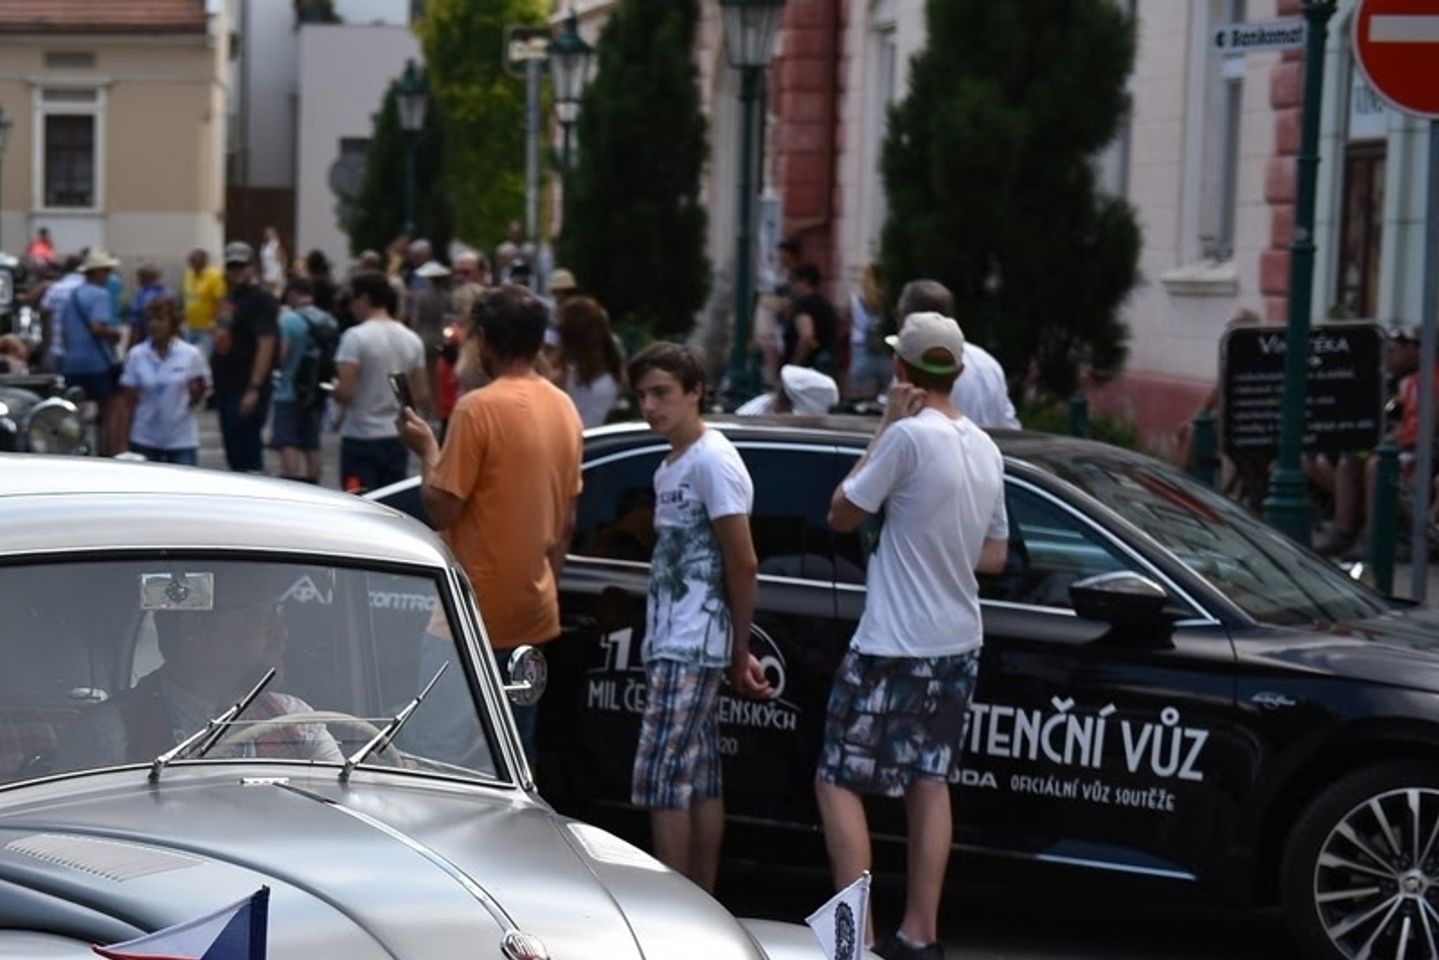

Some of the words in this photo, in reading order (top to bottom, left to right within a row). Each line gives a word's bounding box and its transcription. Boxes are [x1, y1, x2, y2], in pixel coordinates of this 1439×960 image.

[588, 679, 620, 710] MIL
[962, 695, 1117, 769] TENČNÍ
[1121, 706, 1210, 781] VŮZ
[1010, 773, 1080, 799] OFICIÁLNÍ
[1082, 779, 1110, 803] VŮZ
[1115, 786, 1176, 812] SOUTĚŽE
